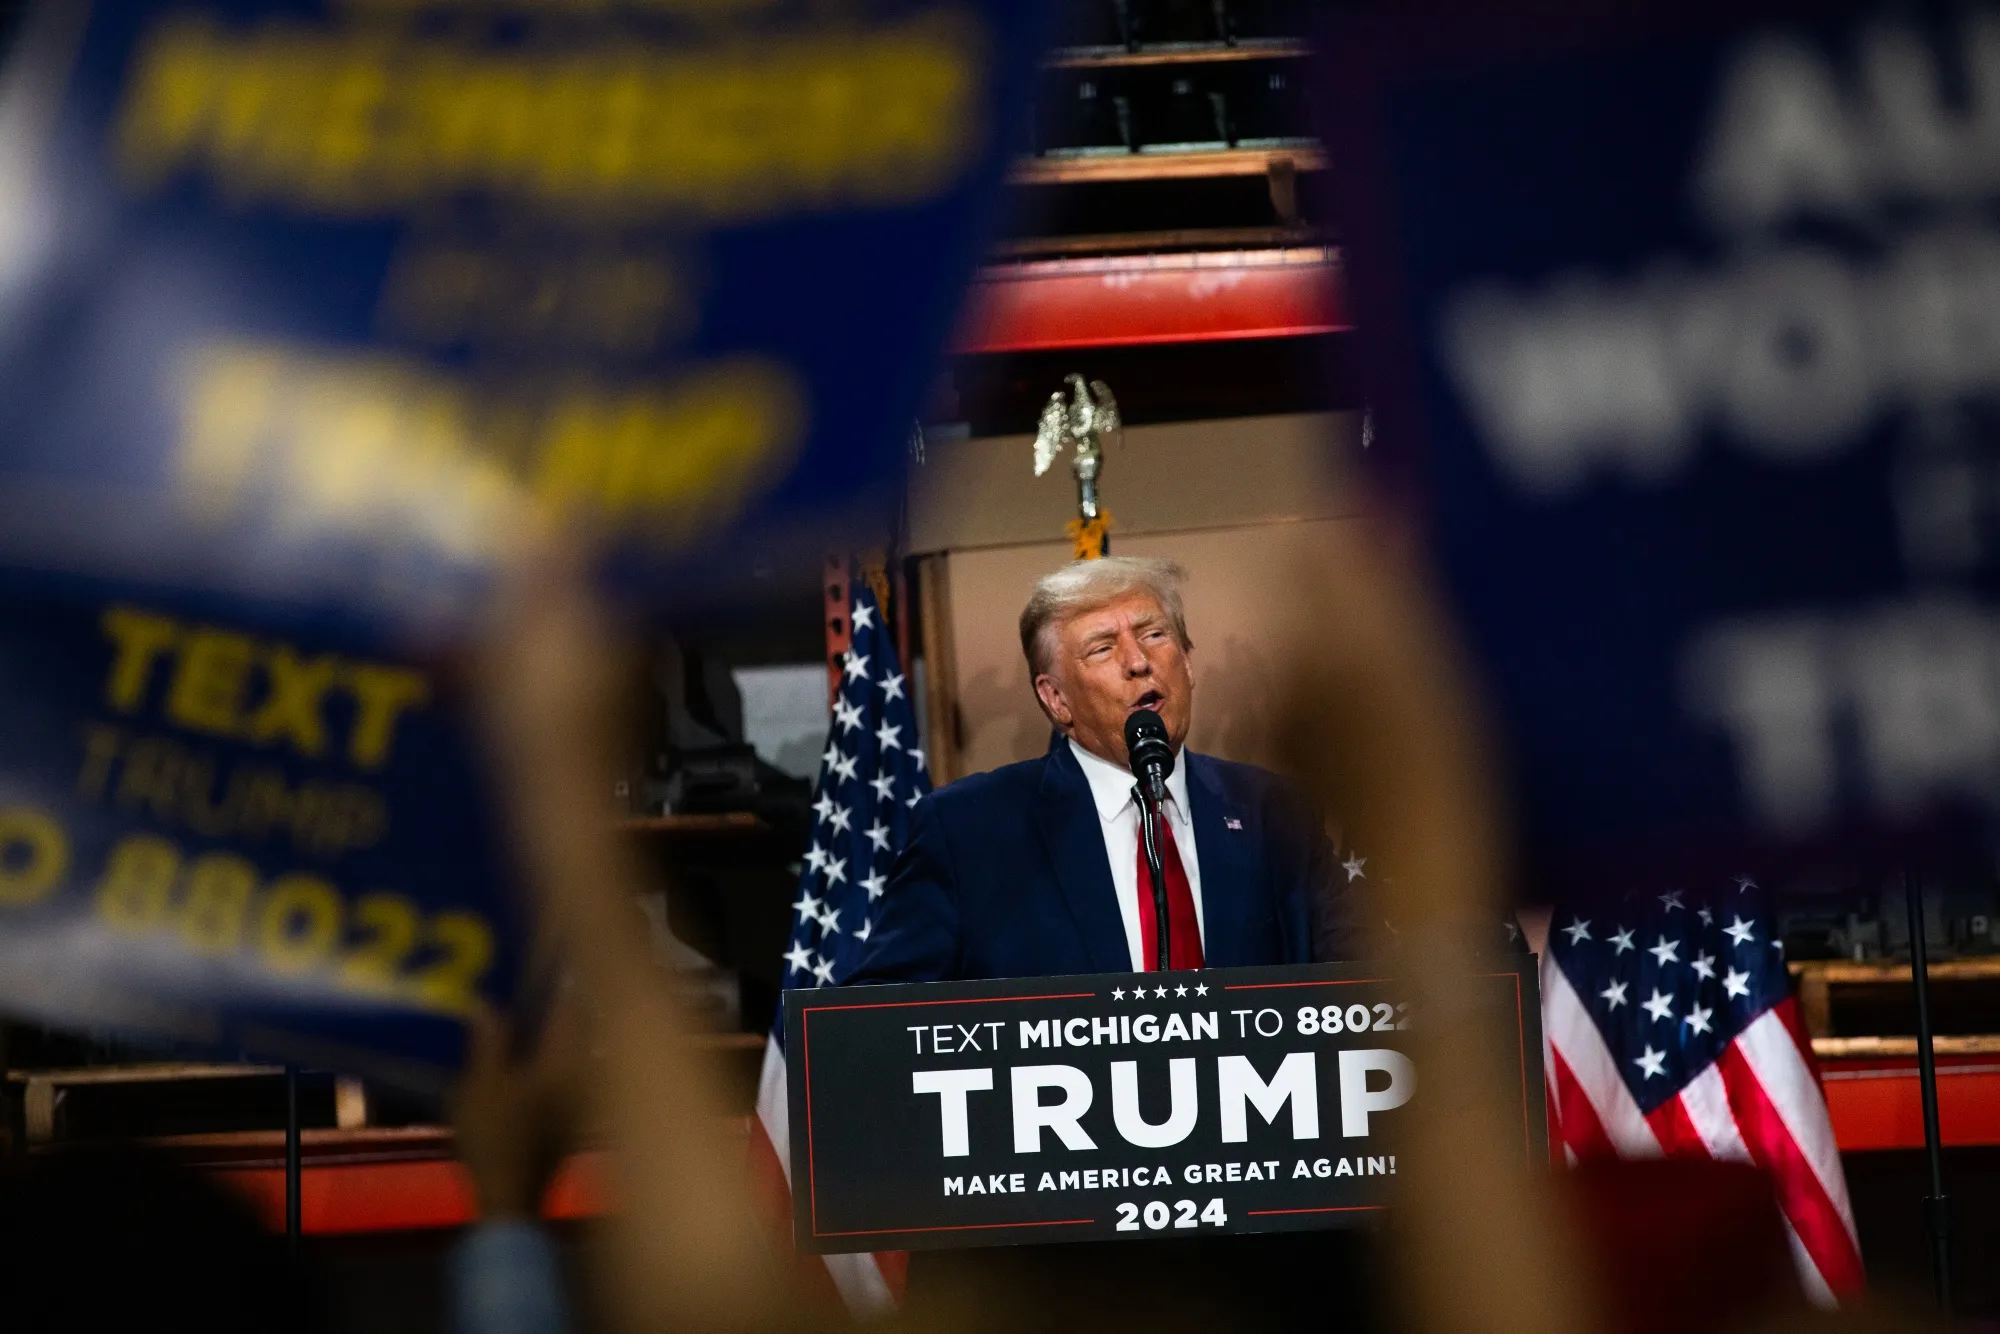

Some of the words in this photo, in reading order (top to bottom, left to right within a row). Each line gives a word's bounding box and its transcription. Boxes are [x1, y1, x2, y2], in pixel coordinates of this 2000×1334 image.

[100, 604, 430, 768] TEXT
[95, 836, 496, 1015] 88022
[906, 1022, 1006, 1055] TEXT
[1019, 1011, 1219, 1049] MICHIGAN
[1230, 1008, 1283, 1038] TO
[912, 1048, 1418, 1158] TRUMP
[943, 1174, 1026, 1197] MAKE
[1037, 1166, 1173, 1192] AMERICA
[1183, 1160, 1280, 1186] GREAT
[1291, 1155, 1397, 1179] AGAIN!
[1115, 1197, 1228, 1232] 2024
